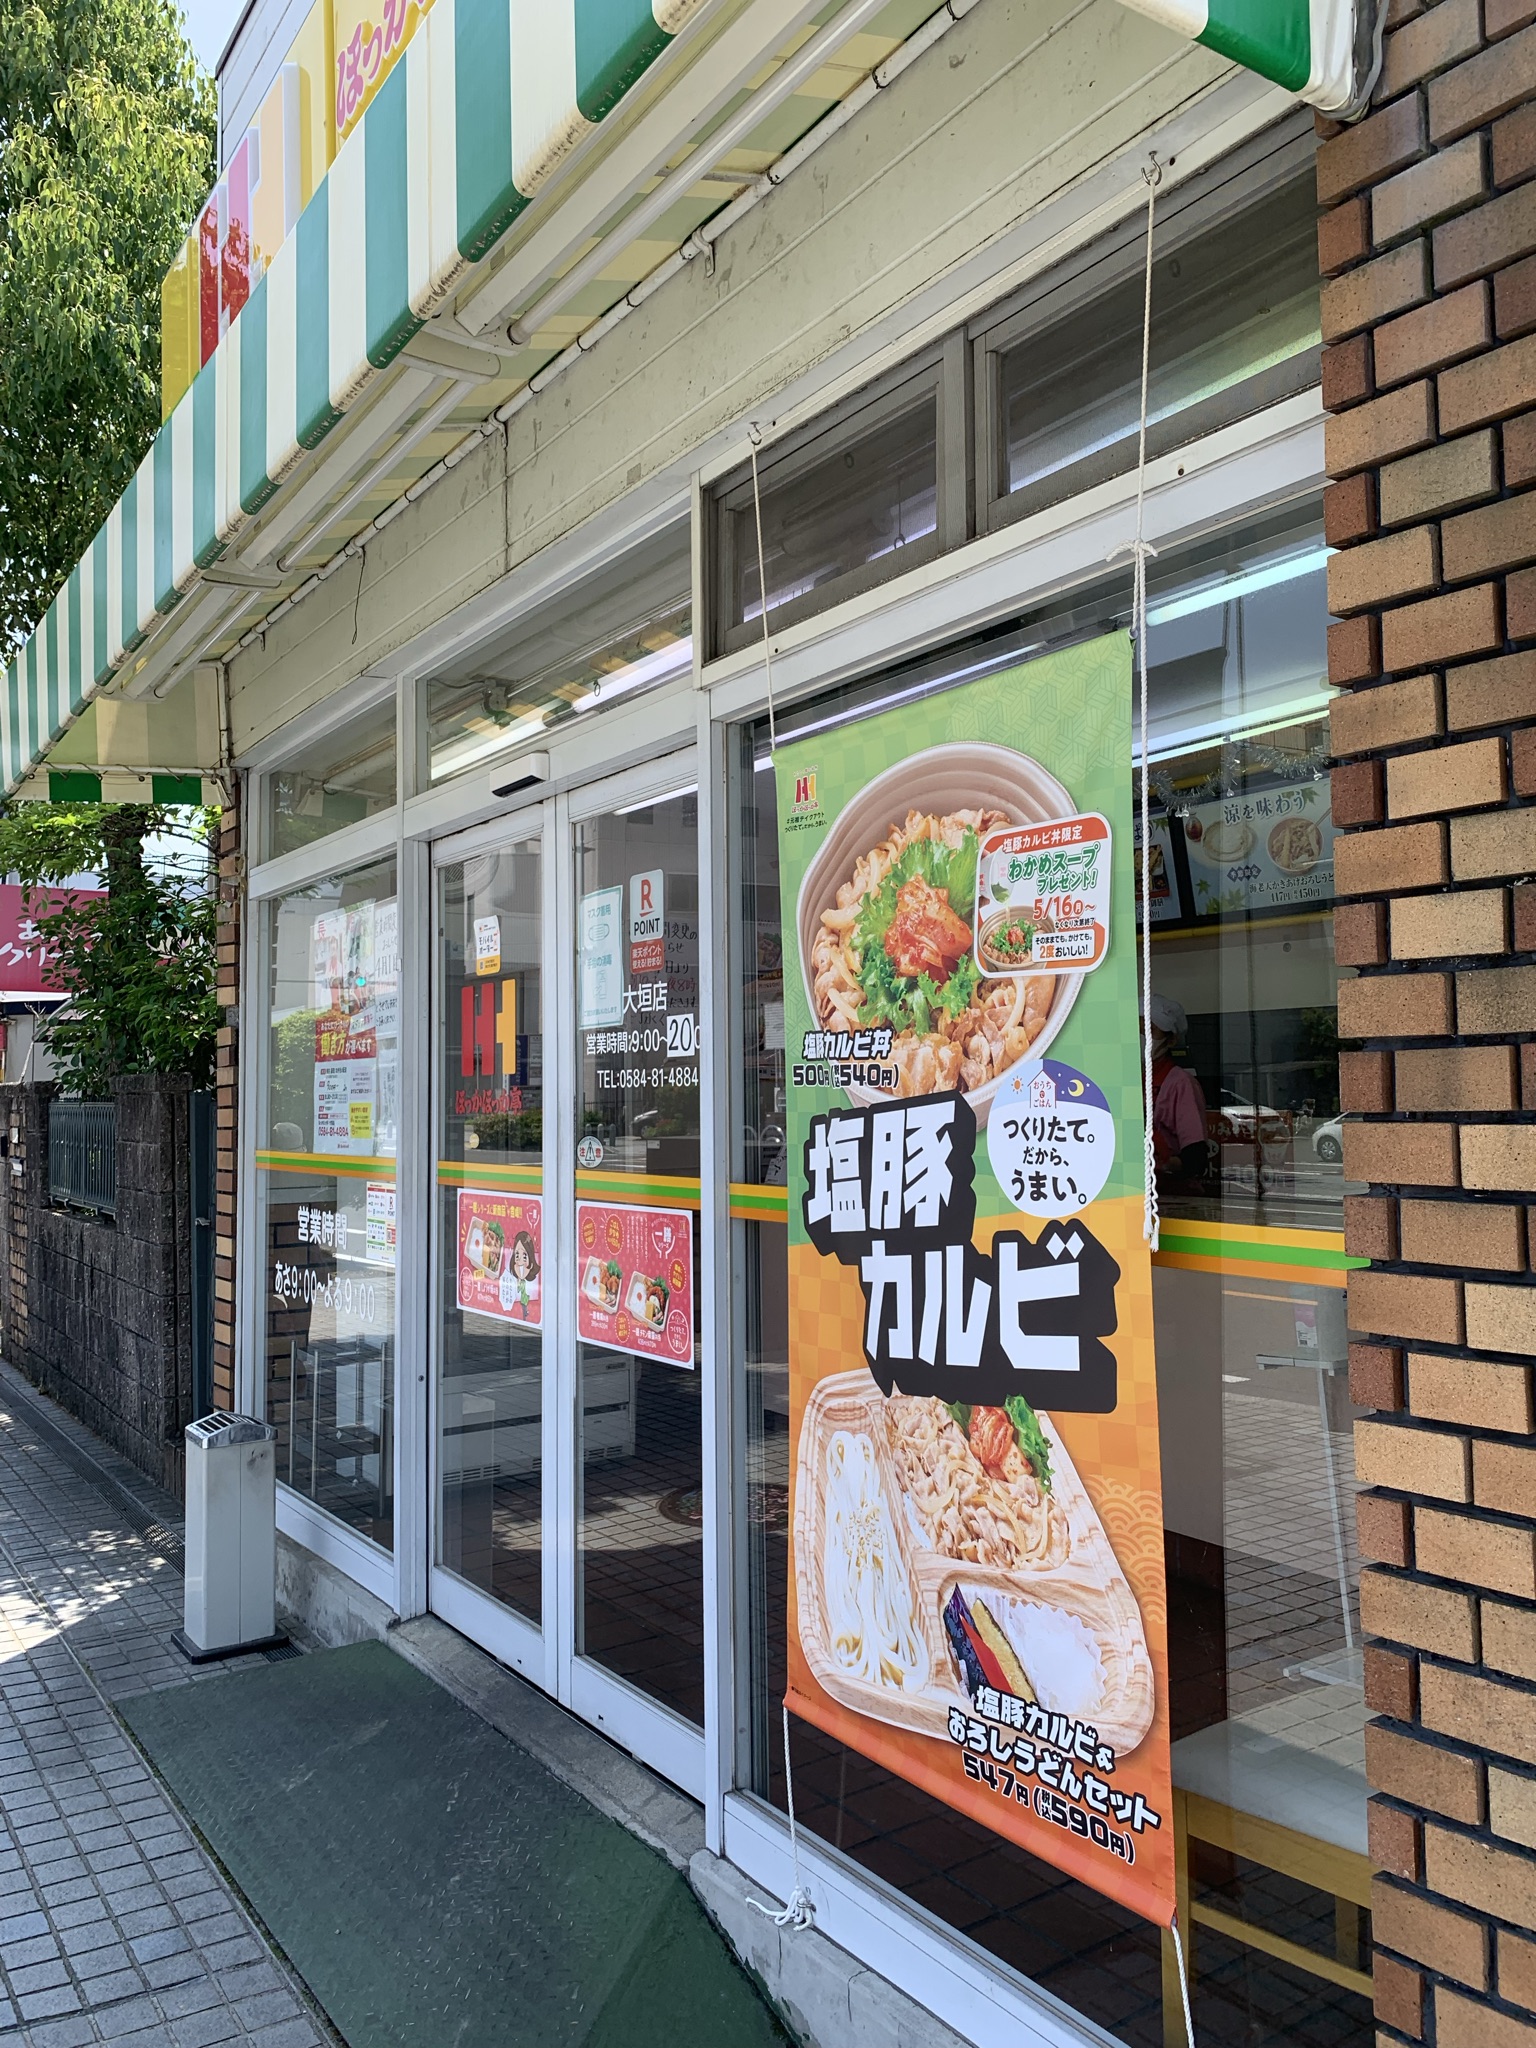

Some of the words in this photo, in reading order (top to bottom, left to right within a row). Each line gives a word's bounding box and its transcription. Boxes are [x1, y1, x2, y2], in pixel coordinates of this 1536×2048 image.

[1223, 791, 1306, 827] 涼を味わう
[1003, 825, 1083, 853] 塩豚カルビ丼限定
[1008, 841, 1101, 882] わかめスープ
[1037, 869, 1098, 895] プレゼント!
[634, 918, 661, 936] POINT
[1054, 917, 1096, 930] なくなり次第終了
[1035, 933, 1093, 946] そのままでも。かけても。
[1039, 944, 1089, 960] 2度おいしい!
[622, 980, 668, 1014] 大垣店
[802, 1028, 893, 1060] 塩豚カルビ丼
[597, 1066, 699, 1089] TEL:0584-81-4884
[1033, 1080, 1052, 1090] おうち
[455, 1086, 523, 1115] ほっかほっか亭
[1033, 1099, 1052, 1108] ごはん
[1003, 1116, 1095, 1143] つくりたて。
[806, 1098, 957, 1235] 塩豚
[1023, 1146, 1070, 1167] だから、
[1011, 1169, 1087, 1205] うまい。
[297, 1205, 348, 1250] 営業時間
[861, 1230, 1086, 1372] カルビ
[976, 1684, 1115, 1774] 塩豚カルビ&
[949, 1706, 1162, 1834] おろしうどんセット
